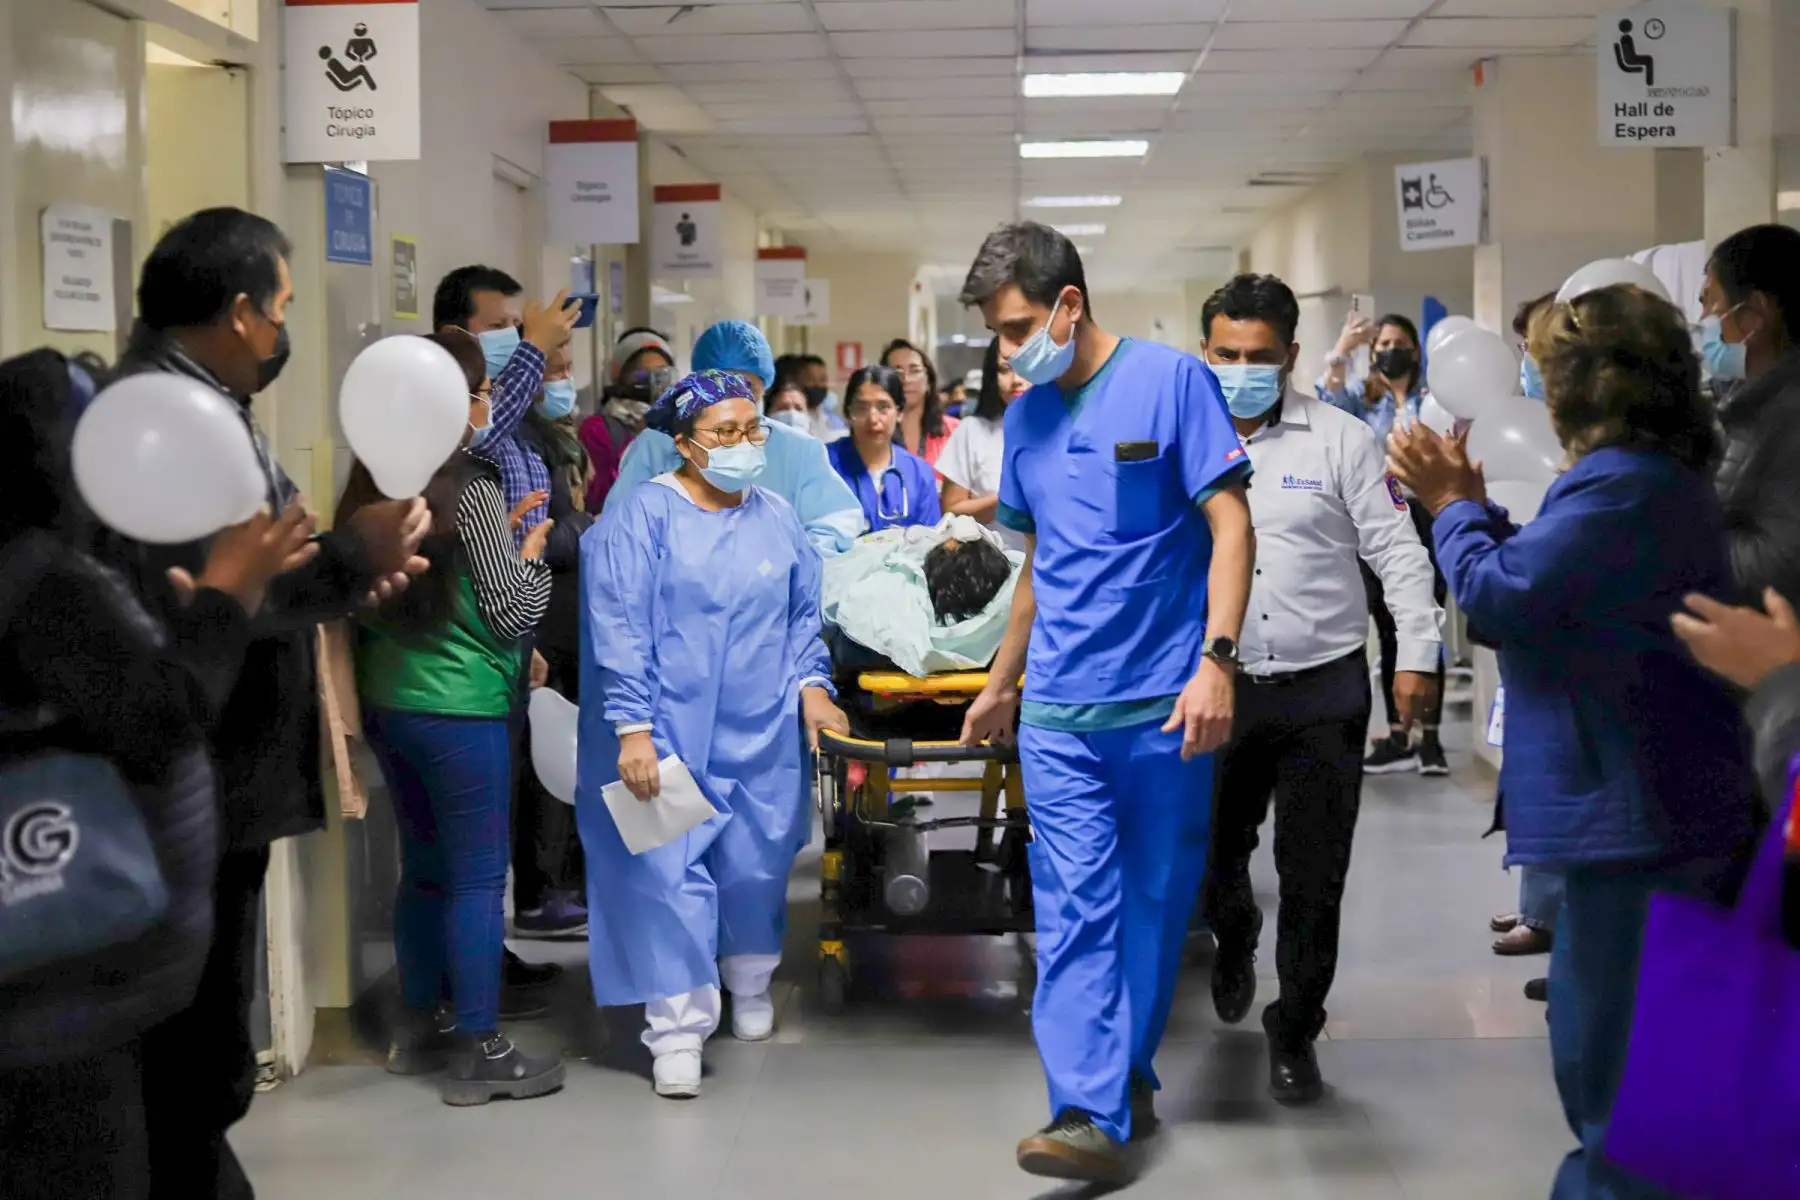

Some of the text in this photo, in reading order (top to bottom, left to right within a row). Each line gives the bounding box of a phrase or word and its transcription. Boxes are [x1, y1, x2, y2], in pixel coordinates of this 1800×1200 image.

[326, 105, 374, 122] Tópico
[1614, 102, 1675, 117] Hall de
[1615, 123, 1676, 140] Espera
